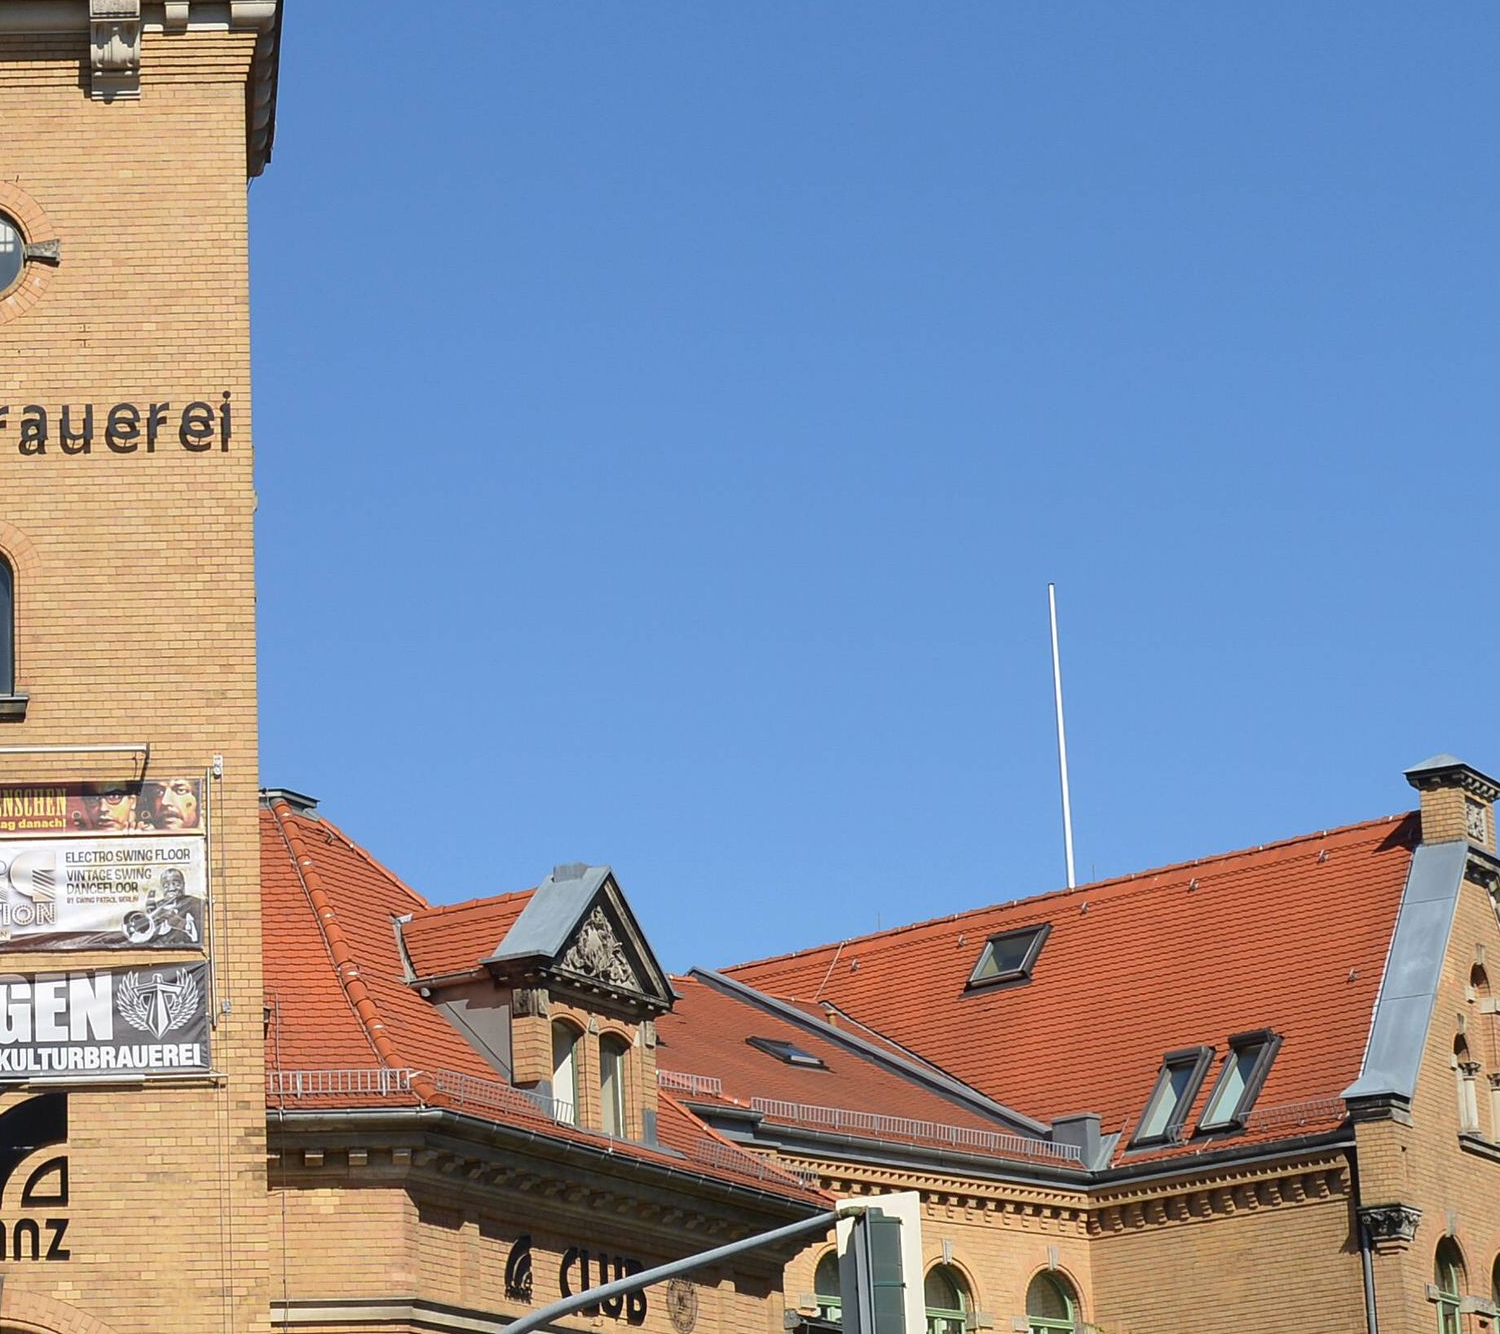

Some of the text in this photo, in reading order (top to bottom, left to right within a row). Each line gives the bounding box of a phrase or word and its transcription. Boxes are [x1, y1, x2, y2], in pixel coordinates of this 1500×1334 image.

[17, 817, 67, 829] danach!
[65, 848, 191, 863] ELECTRO SWING FLOOR
[66, 868, 152, 882] VINTAGE SWING
[66, 882, 139, 895] DANCEFLOOR
[558, 1246, 648, 1327] CLUB
